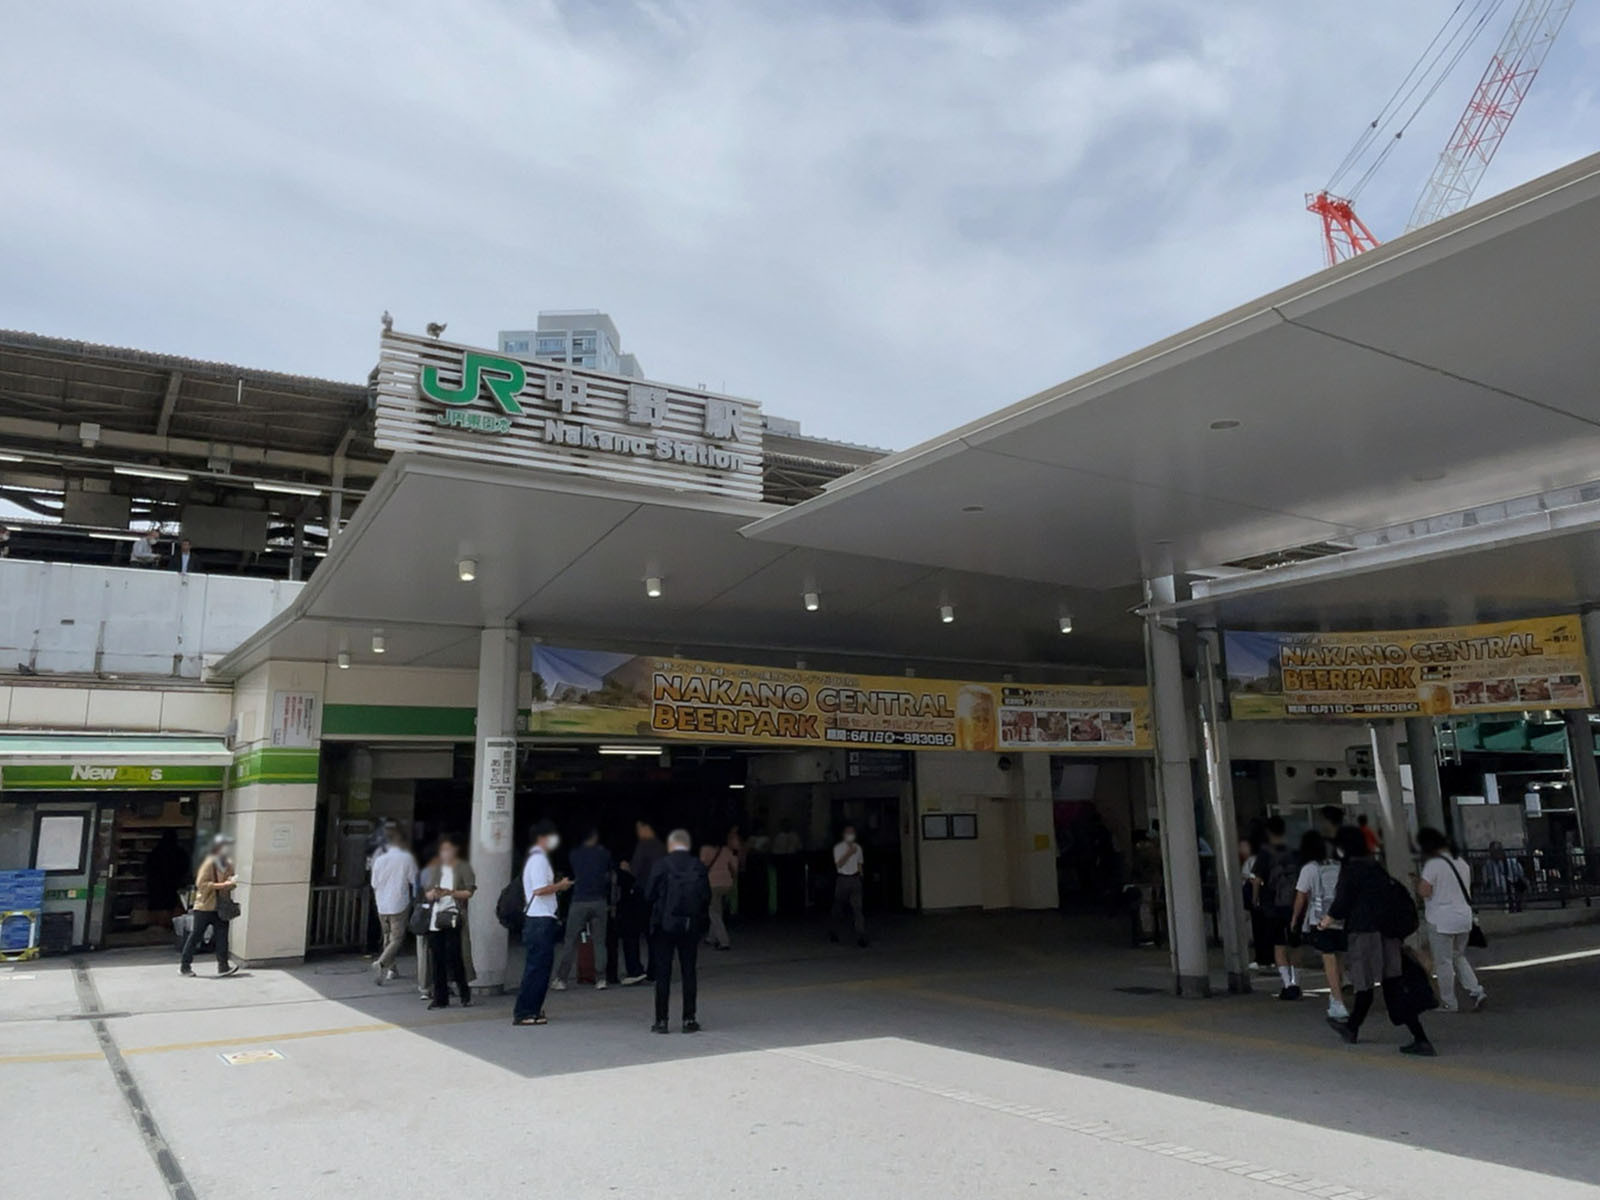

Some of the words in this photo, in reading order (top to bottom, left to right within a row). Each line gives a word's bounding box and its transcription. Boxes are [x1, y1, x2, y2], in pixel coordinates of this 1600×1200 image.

[421, 351, 526, 415] JR
[437, 407, 512, 434] JR東日本
[545, 419, 650, 456] Nakano
[656, 437, 744, 471] Station
[1281, 643, 1407, 667] NAKANO
[1410, 633, 1544, 662] CENTRAL
[653, 673, 810, 712] NAKANO
[816, 687, 955, 718] CENTRAL
[1283, 666, 1417, 691] BEERPARK
[652, 704, 820, 739] BEERPARK
